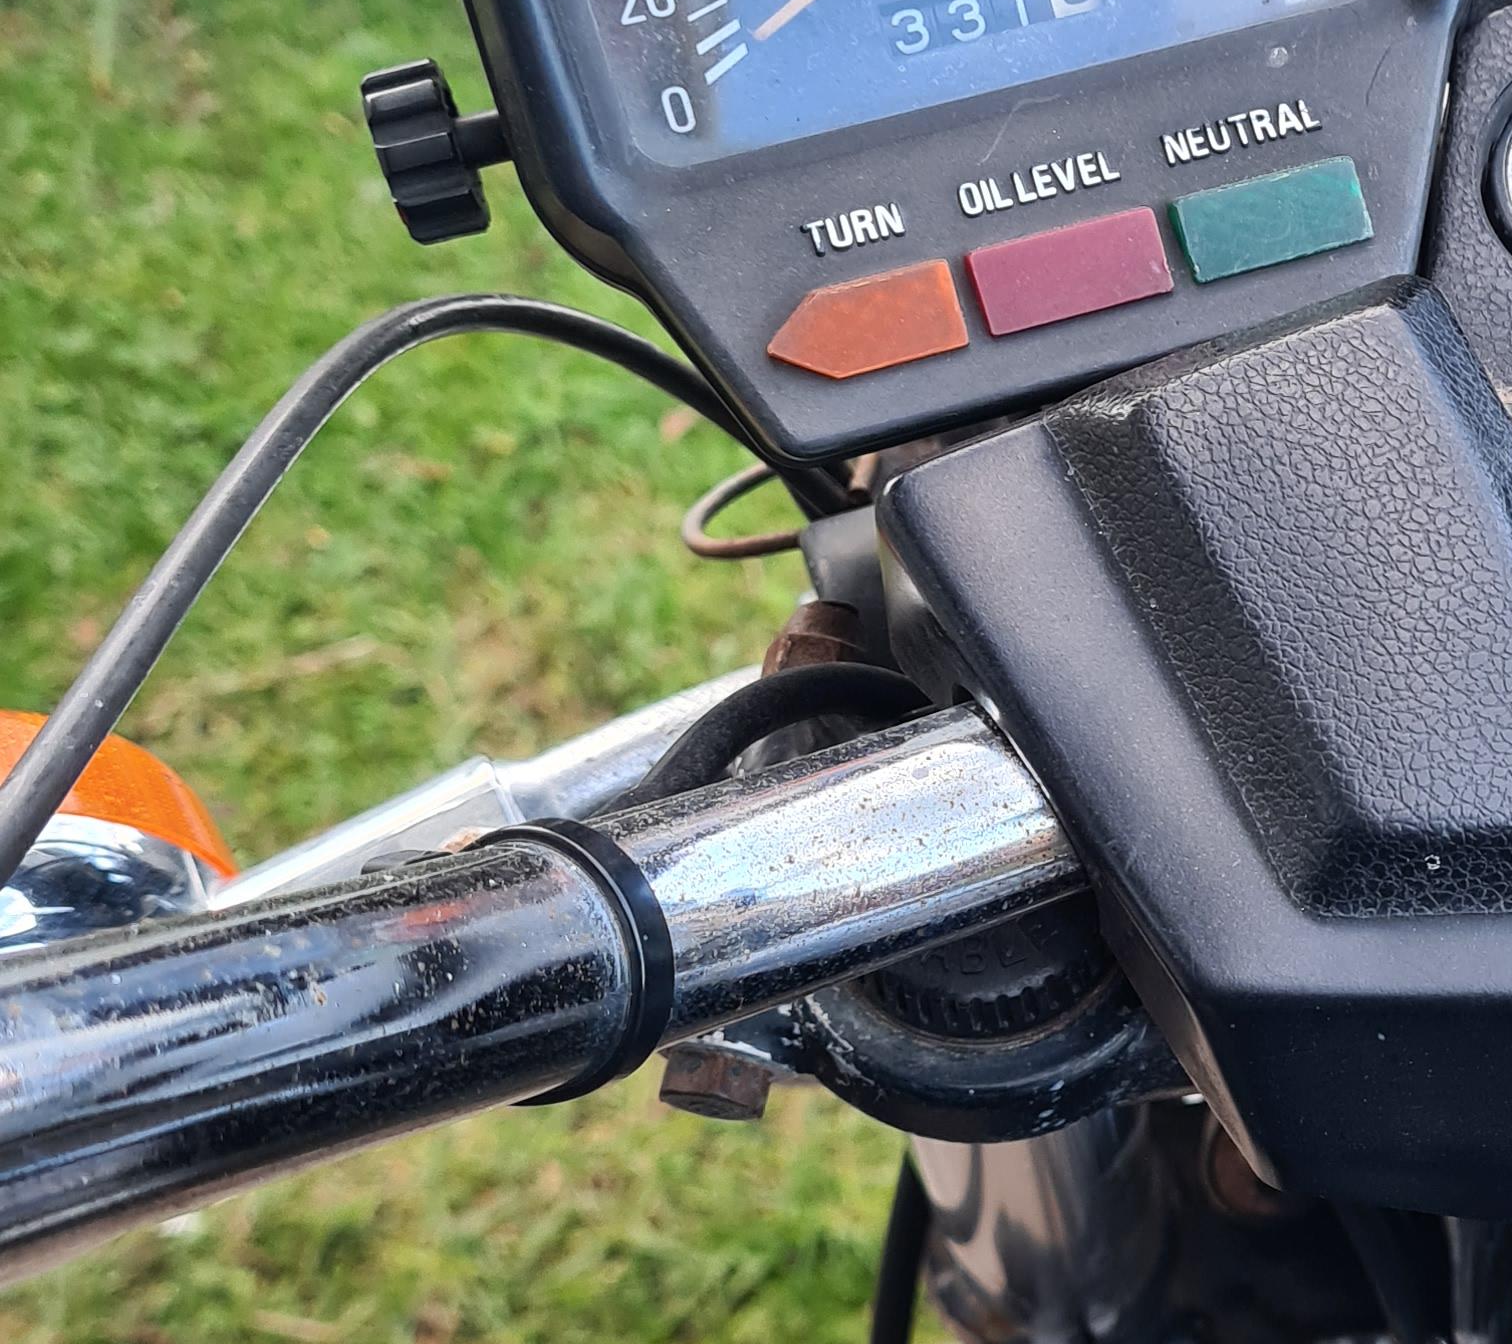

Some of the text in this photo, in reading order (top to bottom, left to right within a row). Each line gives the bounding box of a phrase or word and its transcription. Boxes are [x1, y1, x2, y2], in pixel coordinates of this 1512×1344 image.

[660, 85, 697, 134] 0
[1160, 99, 1322, 166] NEUTRAL
[803, 202, 906, 257] TURN
